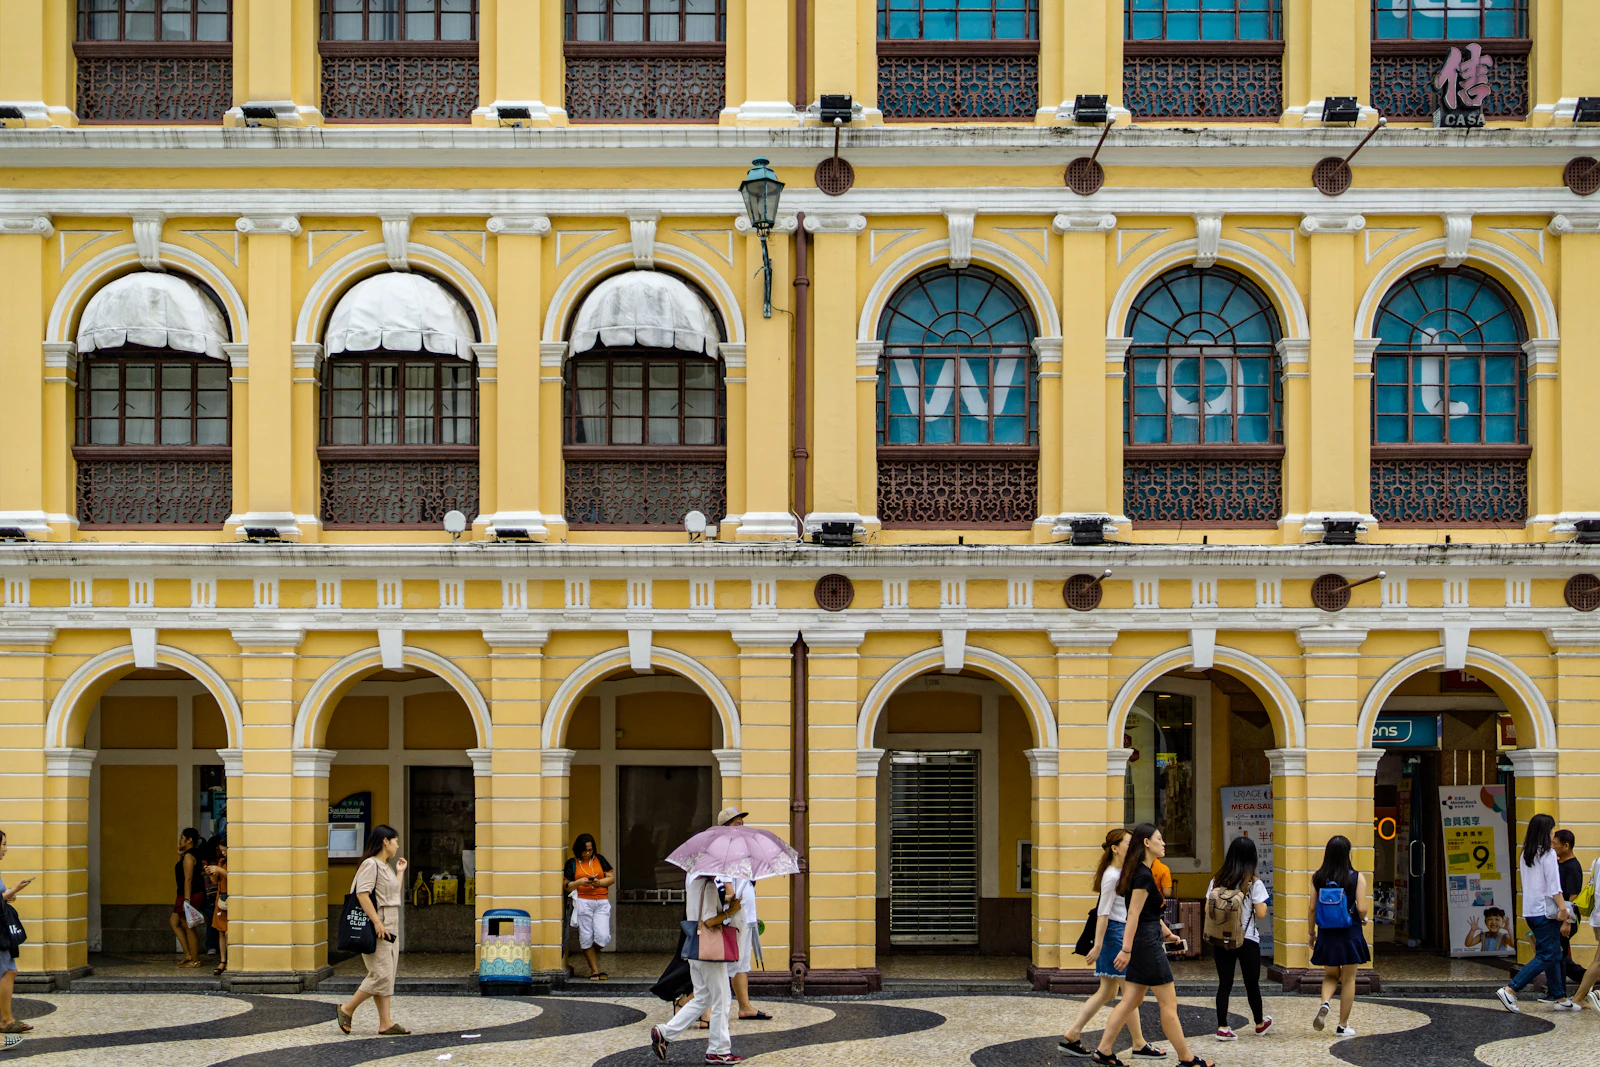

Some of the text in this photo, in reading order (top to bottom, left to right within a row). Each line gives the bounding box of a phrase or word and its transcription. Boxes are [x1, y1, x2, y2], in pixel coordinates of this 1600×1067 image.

[1445, 114, 1486, 126] CASA
[1233, 790, 1262, 799] URIAGE
[1443, 816, 1480, 827] 會員獨享
[1473, 845, 1489, 870] 9
